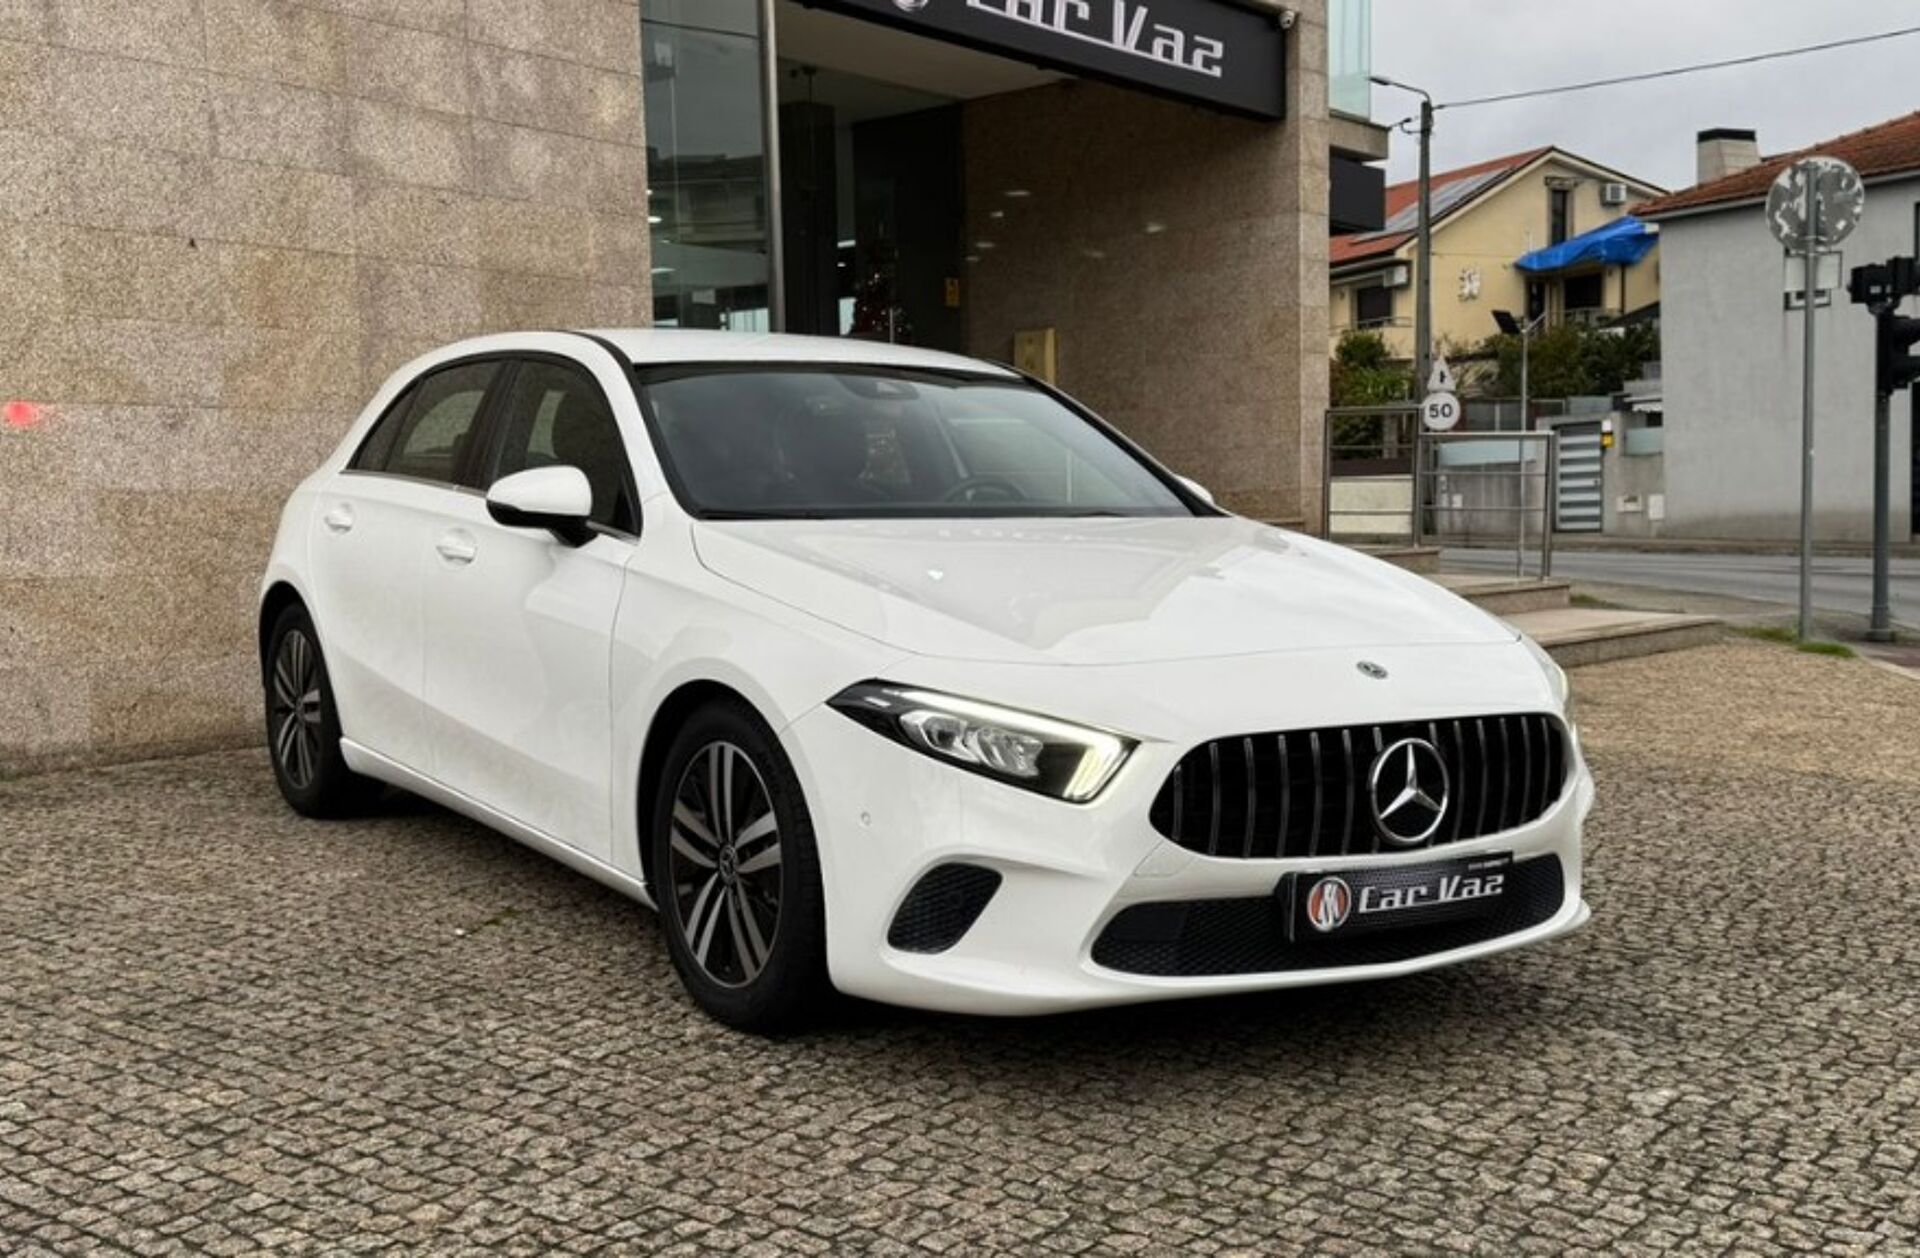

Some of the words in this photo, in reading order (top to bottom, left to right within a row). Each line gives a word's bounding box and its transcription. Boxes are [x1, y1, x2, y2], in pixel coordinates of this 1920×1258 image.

[966, 0, 1090, 33] ar
[1112, 0, 1224, 78] Vaz
[1429, 403, 1453, 418] 50
[1359, 886, 1428, 914] Car
[1438, 874, 1505, 902] Vaz
